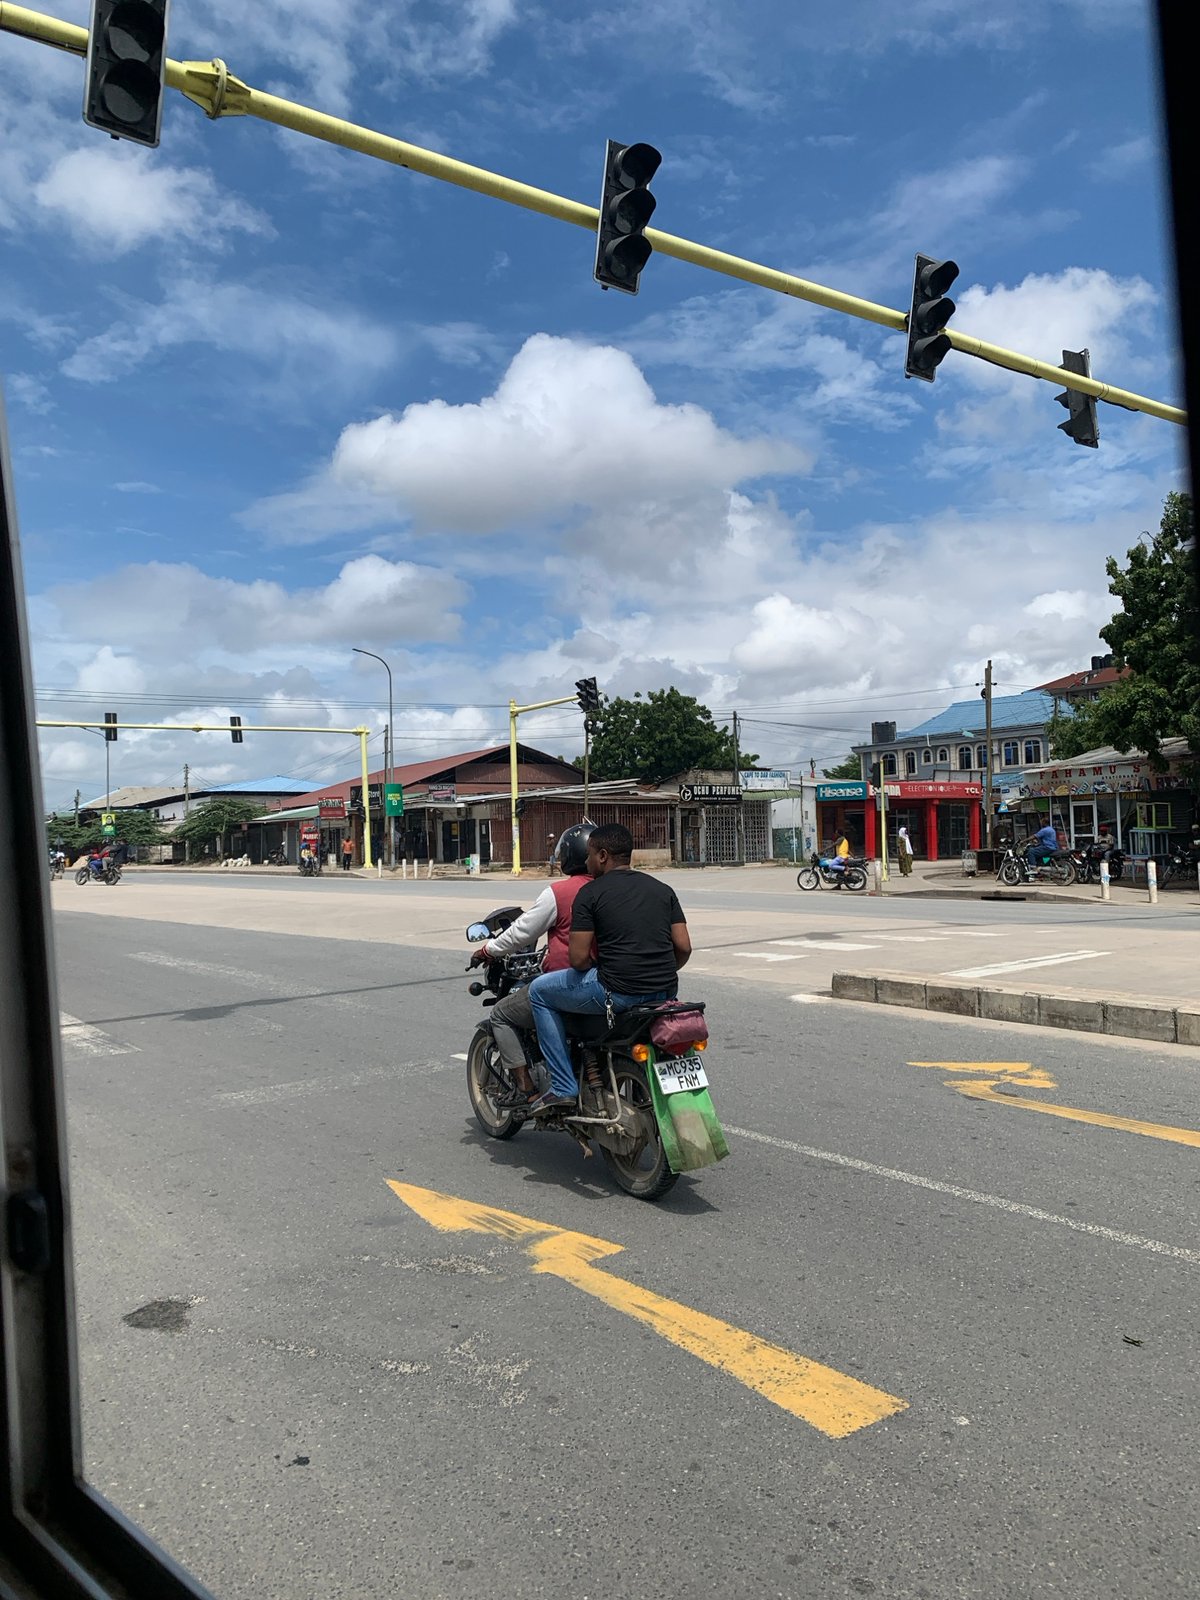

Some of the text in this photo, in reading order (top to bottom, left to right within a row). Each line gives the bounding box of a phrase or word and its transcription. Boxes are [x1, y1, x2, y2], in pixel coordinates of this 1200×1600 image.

[1039, 765, 1117, 779] FAHAMU
[712, 785, 743, 795] PERFUMES
[819, 787, 863, 797] Hisense
[666, 1058, 701, 1076] MC935
[678, 1074, 700, 1089] FNM
